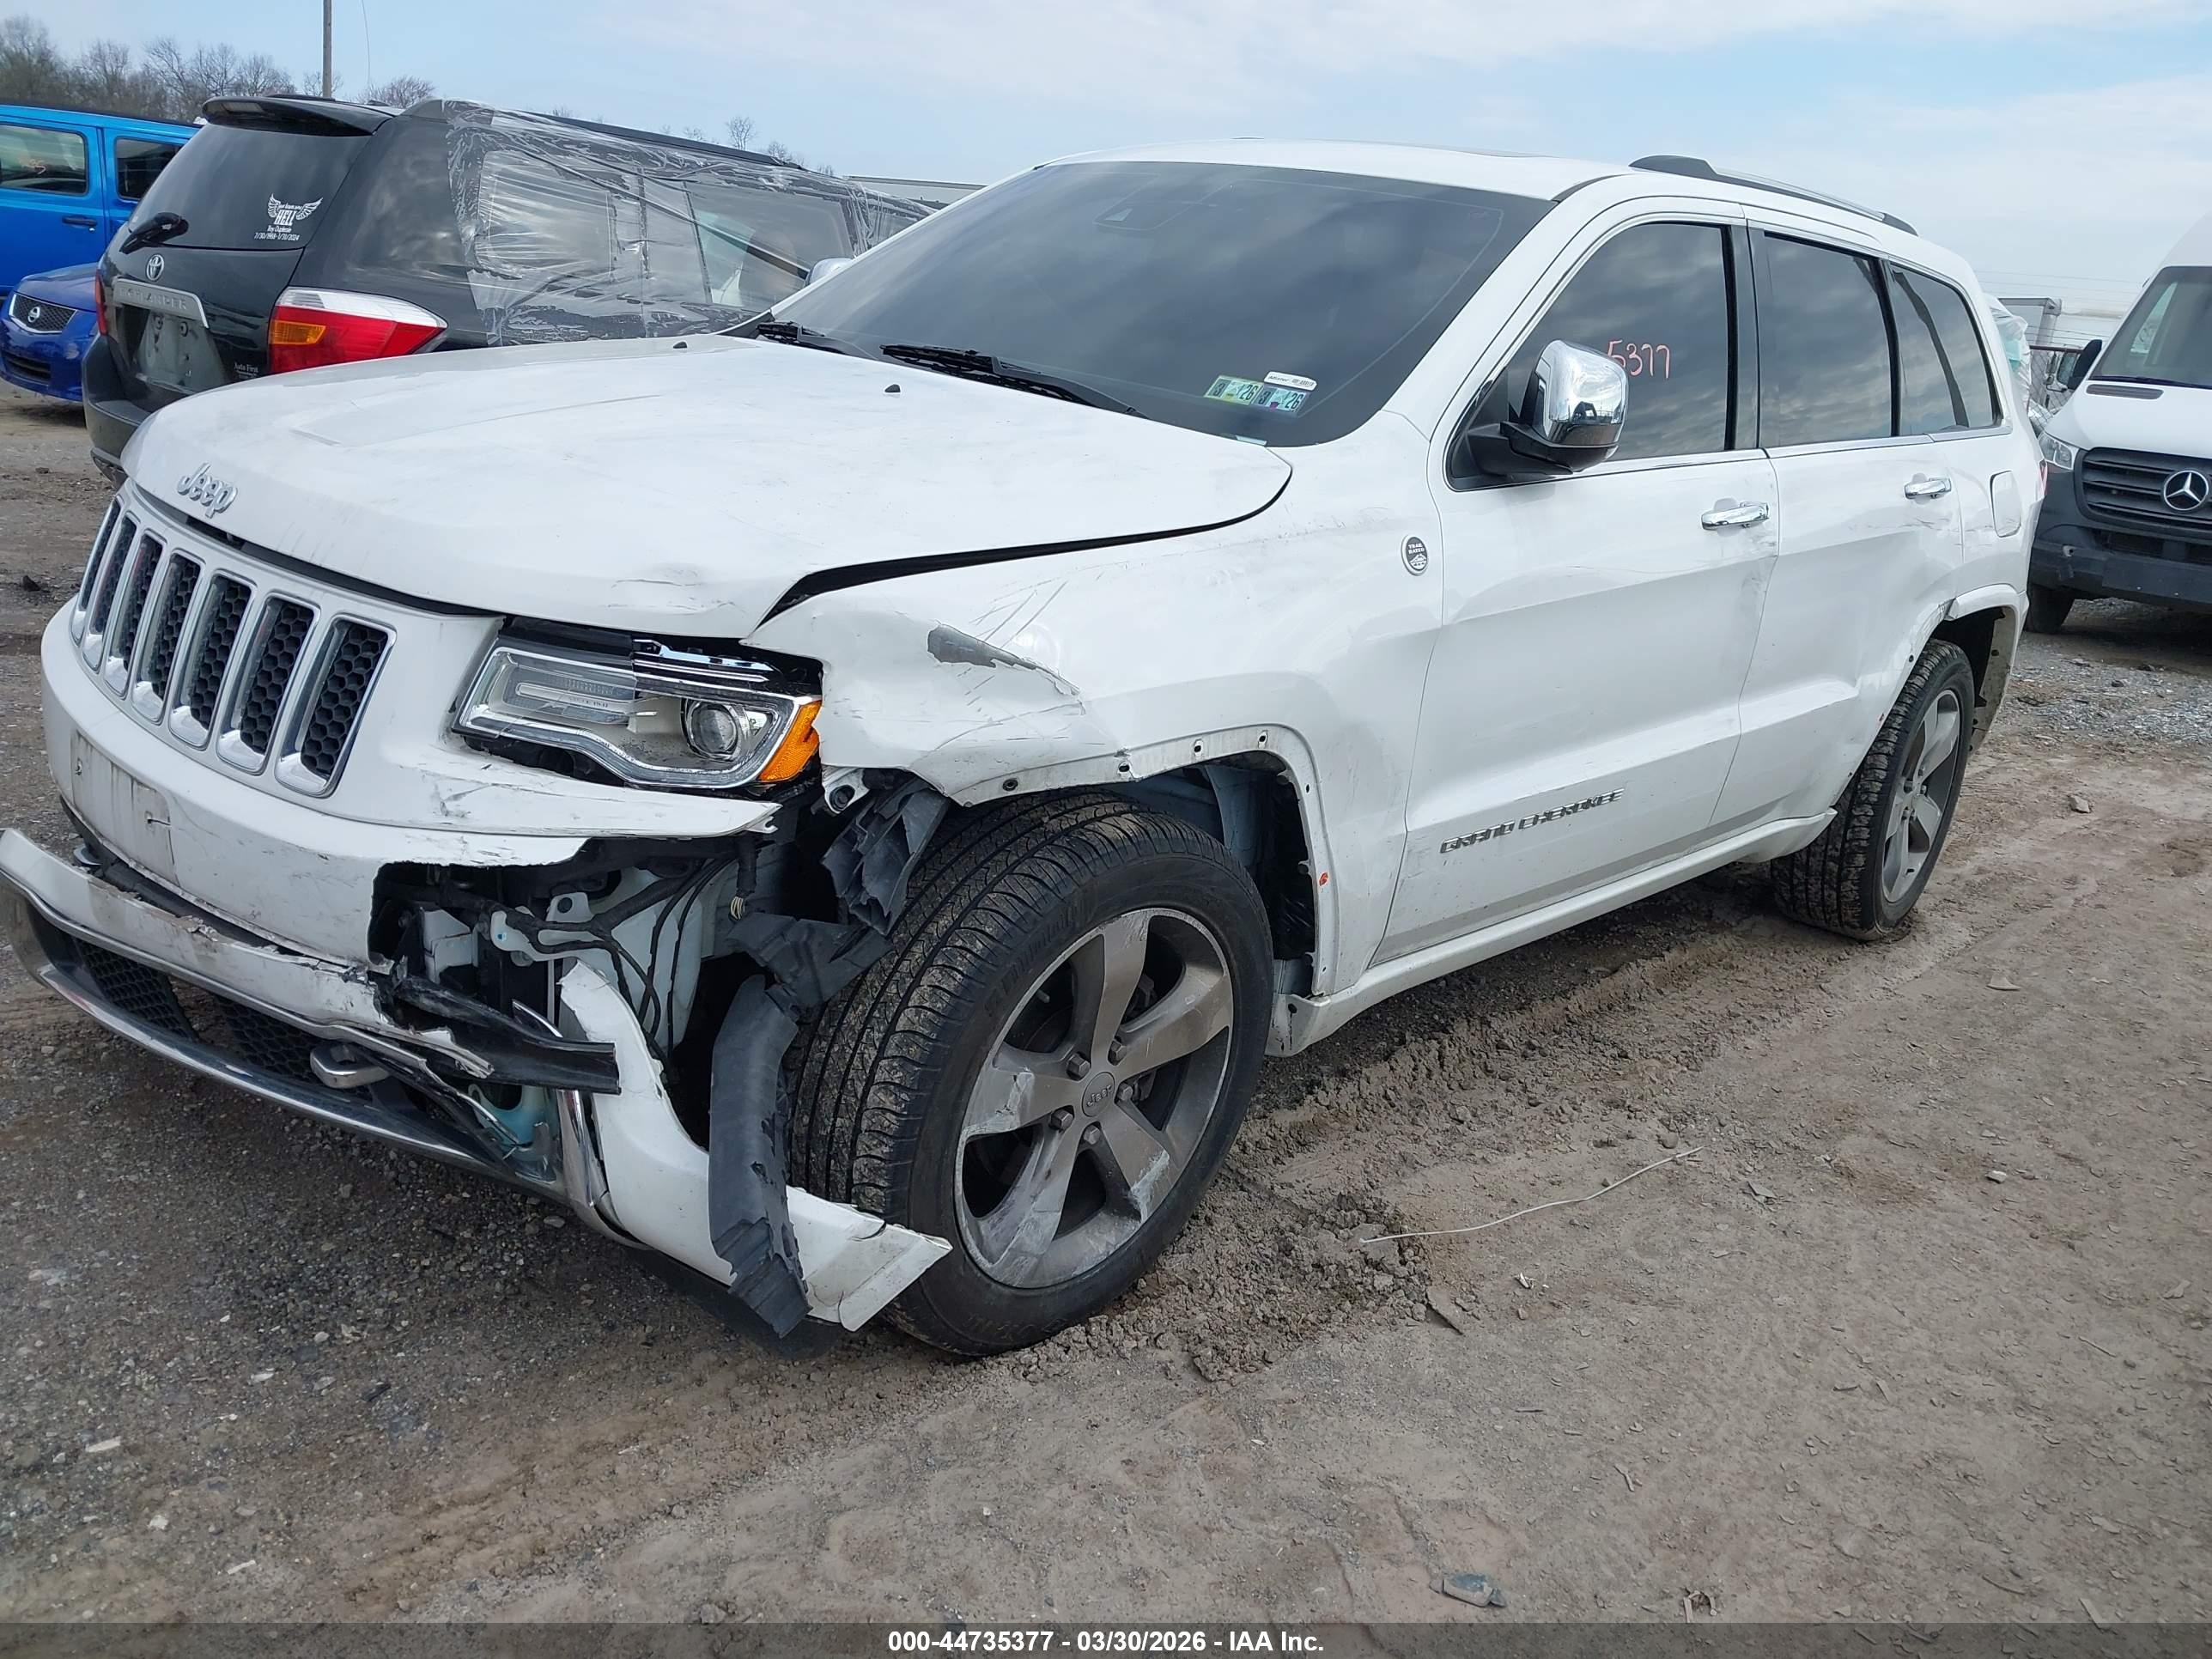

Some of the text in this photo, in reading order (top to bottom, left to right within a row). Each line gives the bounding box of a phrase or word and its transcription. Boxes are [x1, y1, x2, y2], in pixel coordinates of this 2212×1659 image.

[274, 210, 296, 226] HELL
[177, 463, 238, 519] Jeep
[1440, 787, 1625, 854] GRAND CHEROKEE
